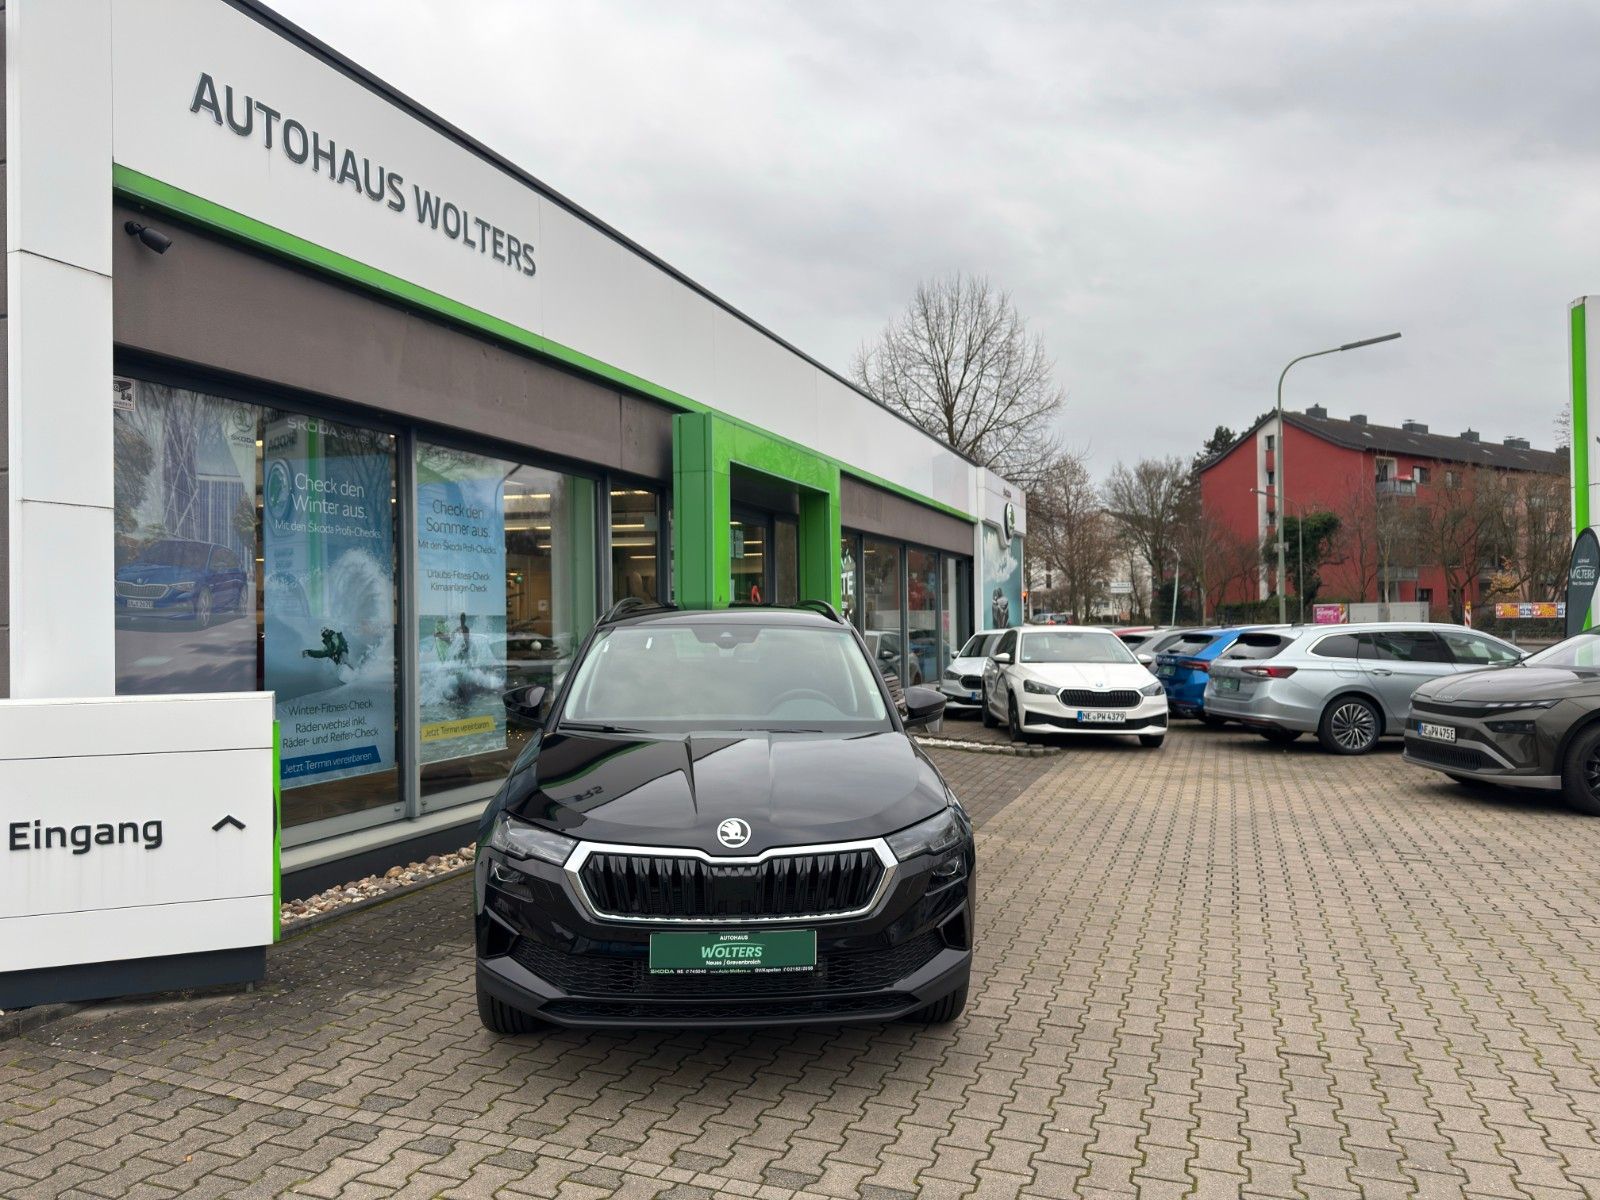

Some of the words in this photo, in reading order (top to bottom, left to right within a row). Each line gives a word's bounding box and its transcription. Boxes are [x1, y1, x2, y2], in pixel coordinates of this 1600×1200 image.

[190, 72, 406, 212] AUTOHAUS
[413, 184, 537, 277] WOLTERS
[294, 472, 338, 494] Check
[340, 480, 365, 498] den
[291, 494, 340, 515] Winter
[342, 504, 368, 519] aus.
[432, 499, 465, 518] Check
[466, 506, 484, 520] den
[274, 519, 290, 531] Mit
[290, 521, 306, 532] den
[426, 516, 470, 535] Sommer
[472, 527, 491, 539] aus.
[288, 698, 374, 716] Winter-Fitness-Check
[295, 717, 351, 733] Räderwechsel
[282, 737, 310, 749] Räder-
[312, 734, 328, 745] und
[330, 727, 379, 742] Reifen-Check
[284, 763, 304, 774] Jetzt
[305, 758, 332, 770] Termin
[332, 752, 372, 765] vereinbaren
[9, 819, 163, 855] Eingang
[701, 944, 763, 959] WOLTERS
